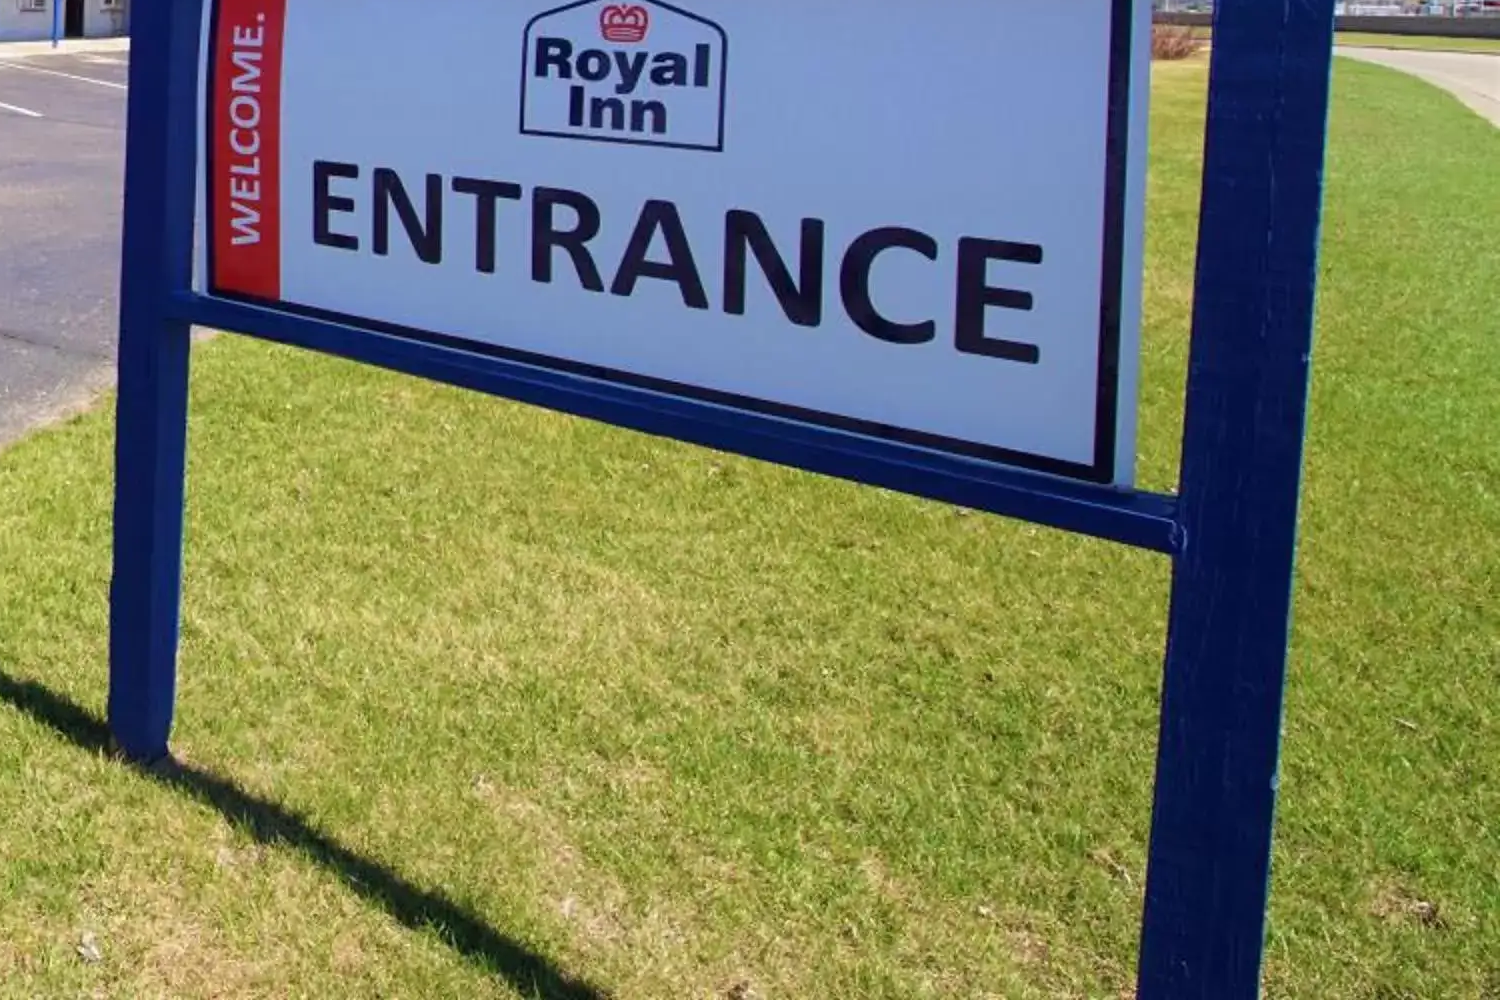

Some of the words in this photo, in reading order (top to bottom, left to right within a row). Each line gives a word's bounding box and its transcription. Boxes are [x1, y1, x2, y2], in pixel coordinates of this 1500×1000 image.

[229, 12, 266, 246] WELCOME.
[534, 36, 711, 94] Royal
[568, 85, 667, 135] Inn
[312, 159, 1043, 365] ENTRANCE
